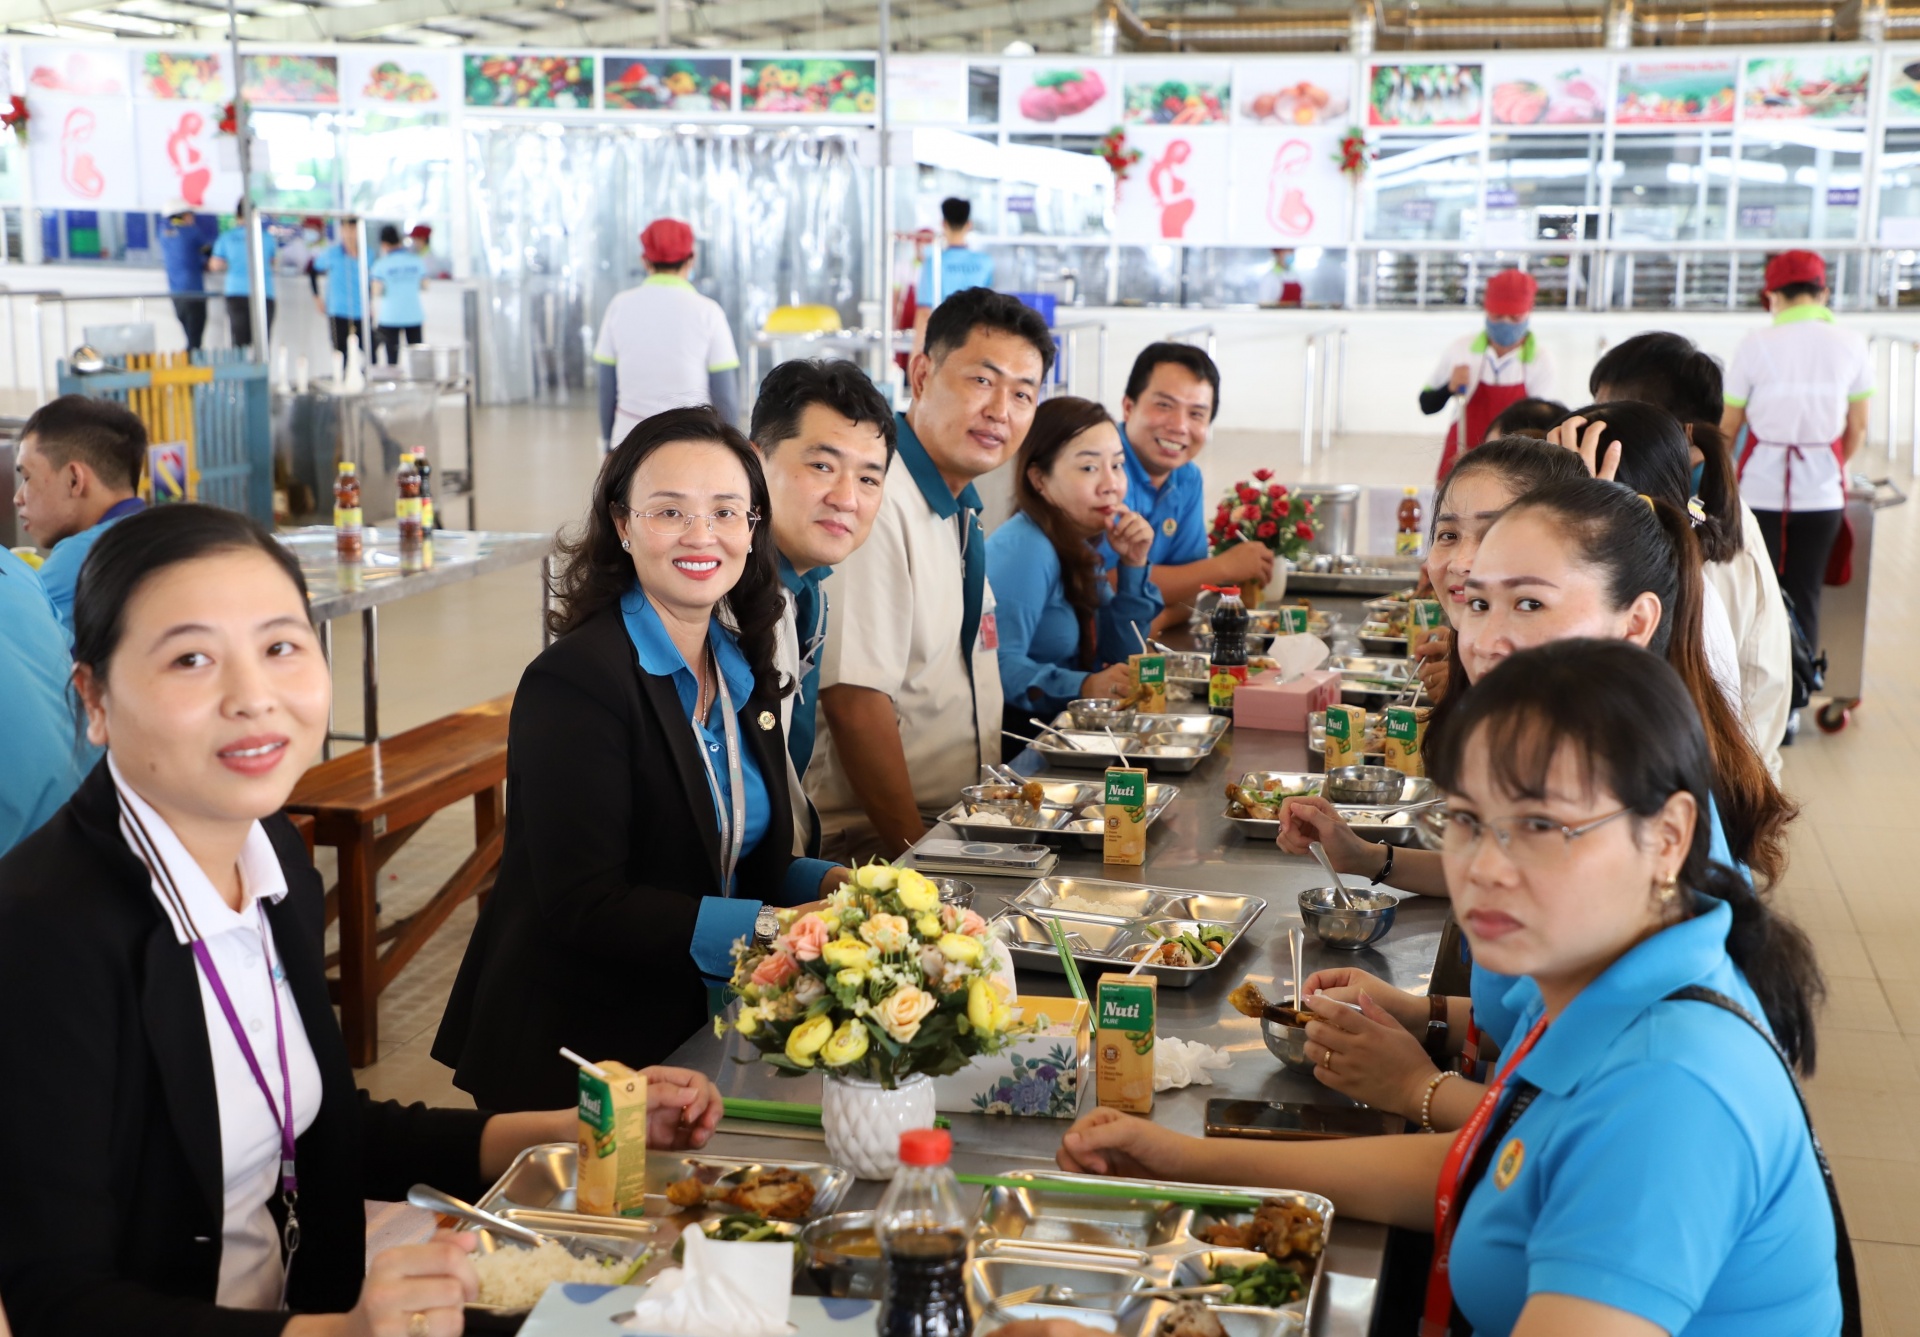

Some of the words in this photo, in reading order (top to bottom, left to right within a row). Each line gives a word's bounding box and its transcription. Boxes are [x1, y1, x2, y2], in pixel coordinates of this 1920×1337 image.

[1142, 666, 1159, 675] Nuti
[1327, 718, 1342, 730] Nuti
[1388, 719, 1408, 732] Nuti
[1109, 784, 1135, 796] Nuti
[1103, 1001, 1139, 1018] Nuti
[580, 1090, 601, 1115] Nuti
